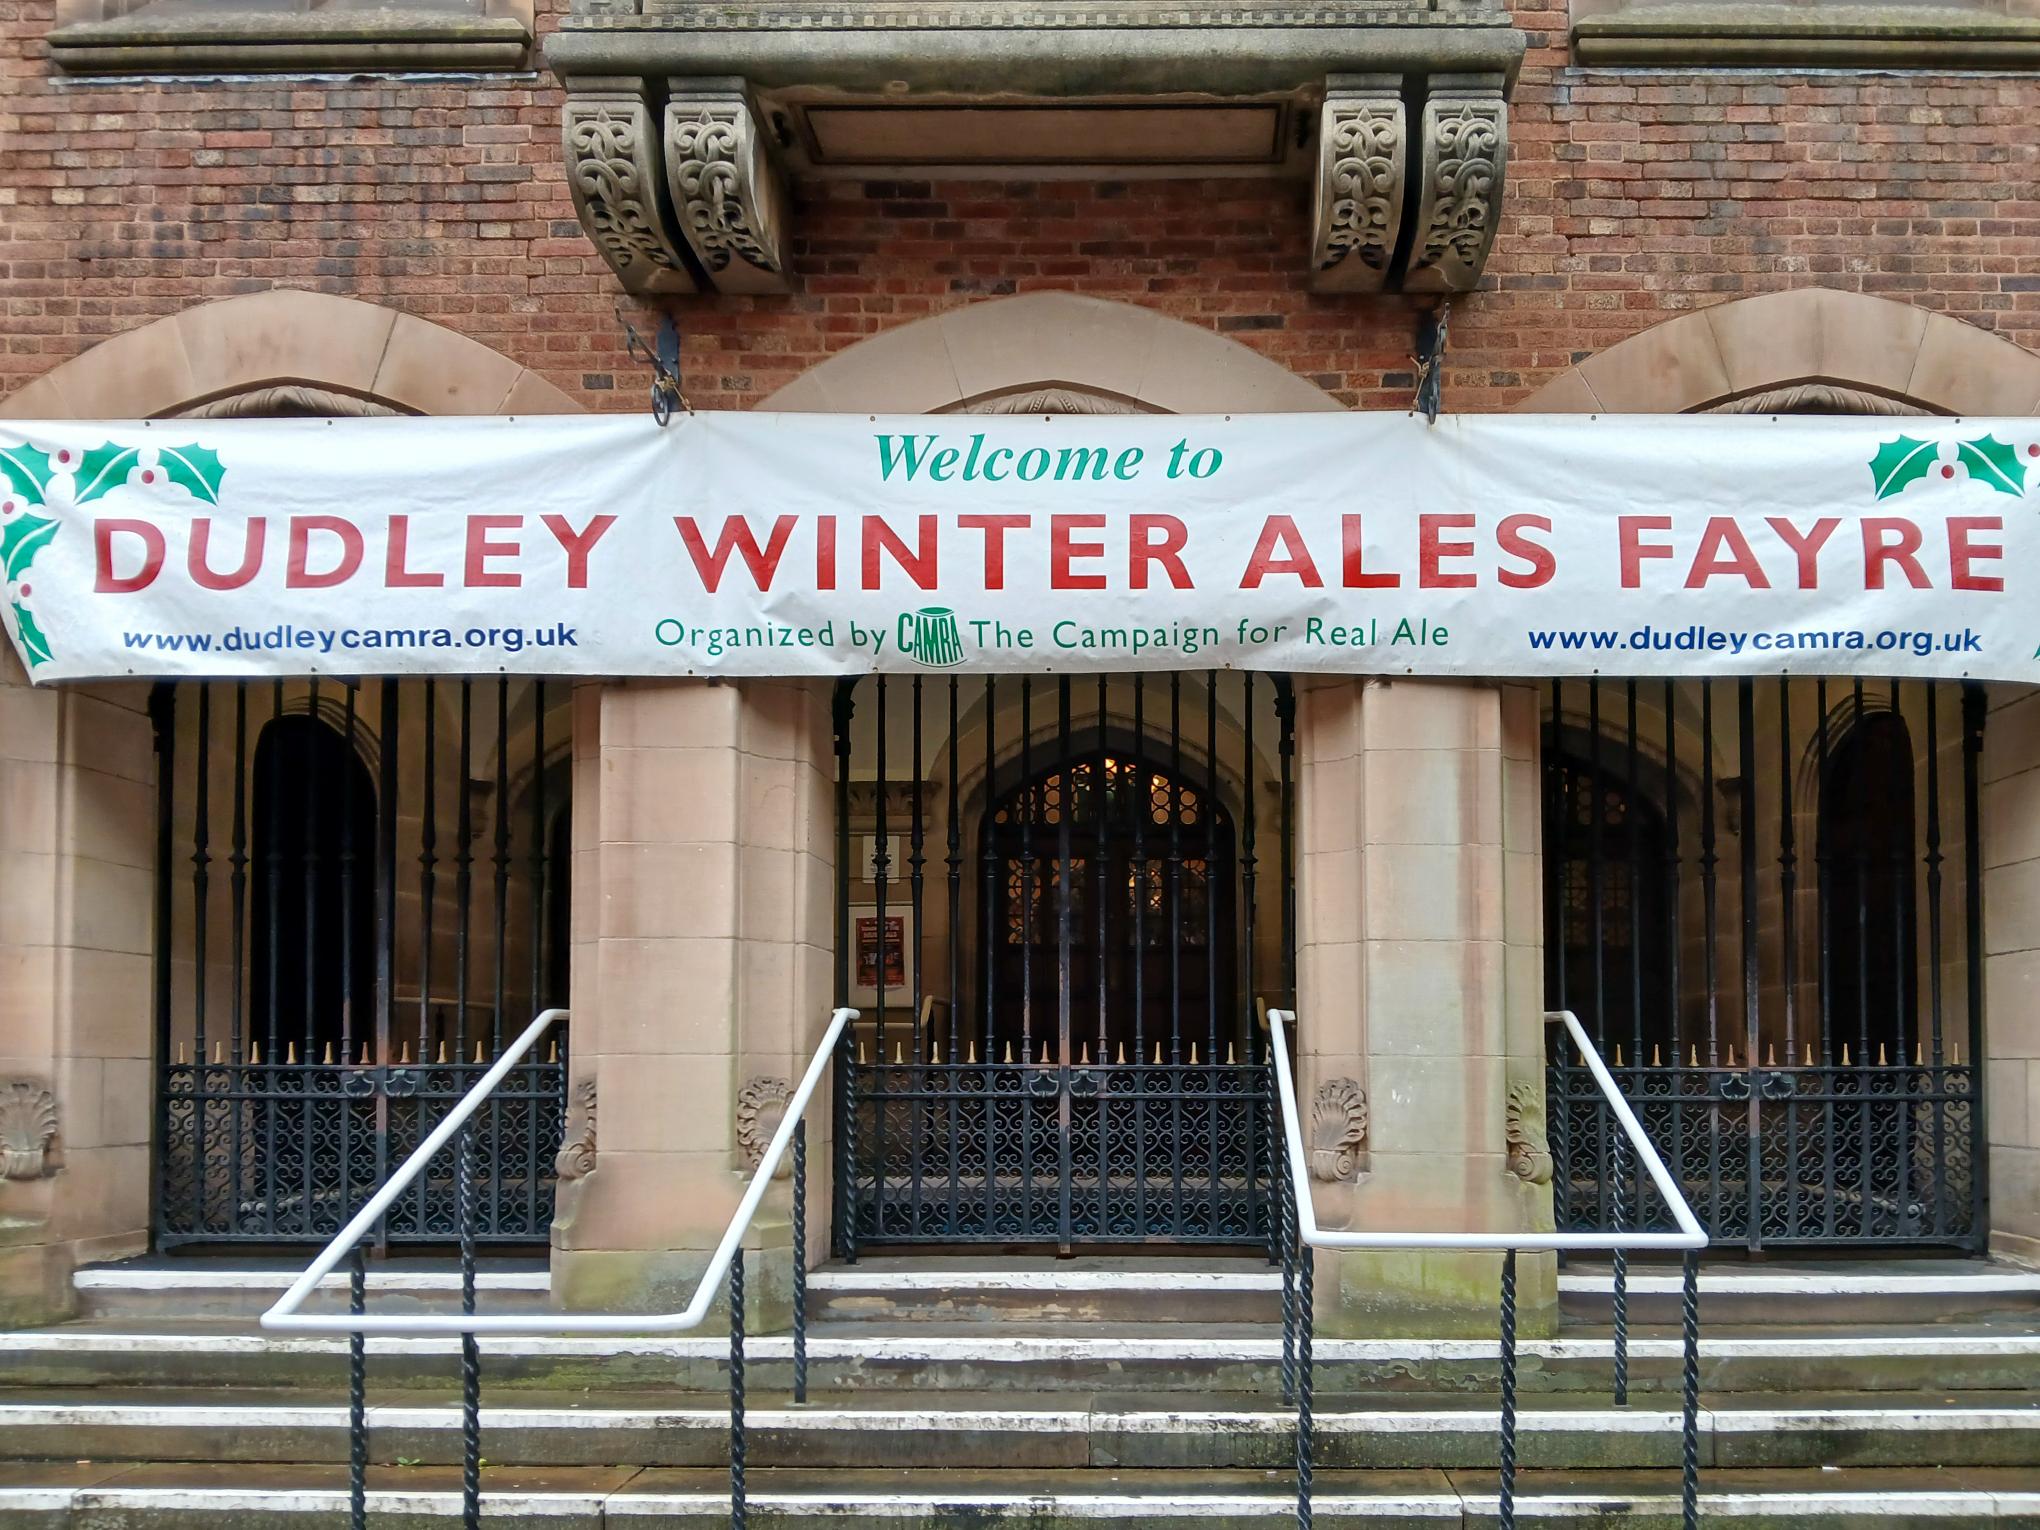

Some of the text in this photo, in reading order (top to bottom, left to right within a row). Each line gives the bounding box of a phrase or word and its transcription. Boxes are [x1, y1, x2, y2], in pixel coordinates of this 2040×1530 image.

[875, 433, 1224, 482] Welcome to
[96, 514, 2004, 593] DUDLEY WINTER ALES FAYRE
[124, 623, 577, 654] www.dudleycamra.org.uk
[655, 612, 1449, 664] Organized by CAMRA The Campaign for Real Ale
[1528, 623, 1982, 657] www.dudleycamra.org.uk
